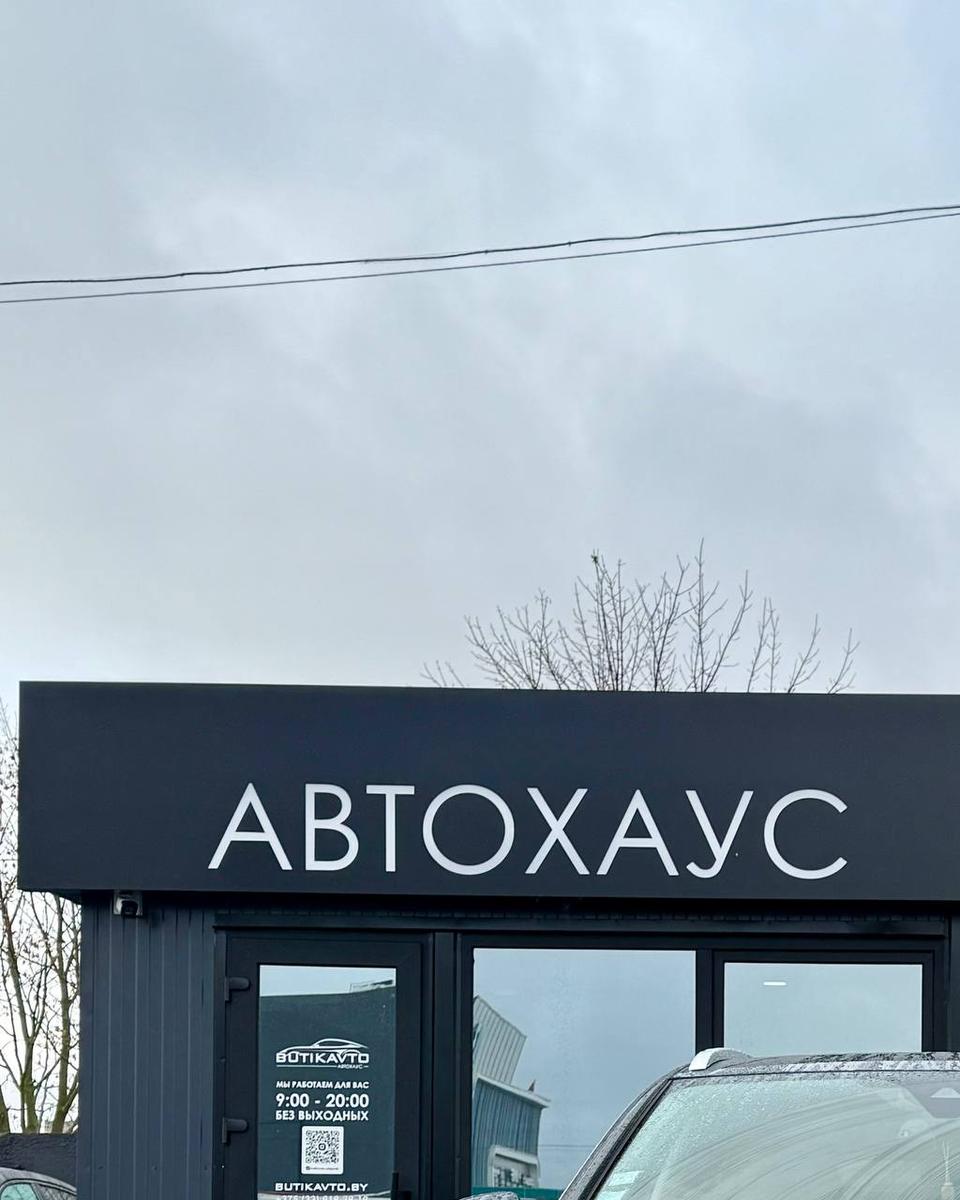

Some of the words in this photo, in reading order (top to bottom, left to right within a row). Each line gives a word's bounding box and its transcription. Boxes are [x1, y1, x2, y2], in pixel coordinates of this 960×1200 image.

[207, 781, 848, 880] АВТОХАУС
[275, 1053, 370, 1064] BUTIKAVTO
[276, 1081, 290, 1089] МЫ
[292, 1081, 333, 1089] РАБОТАЕМ
[334, 1081, 351, 1090] ДЛЯ
[276, 1093, 310, 1108] 9:00
[325, 1093, 370, 1108] 20:00
[275, 1110, 295, 1121] БЕЗ
[298, 1110, 369, 1122] ВЫХОДНЫХ
[275, 1182, 369, 1192] BUTIKAVTO.BY
